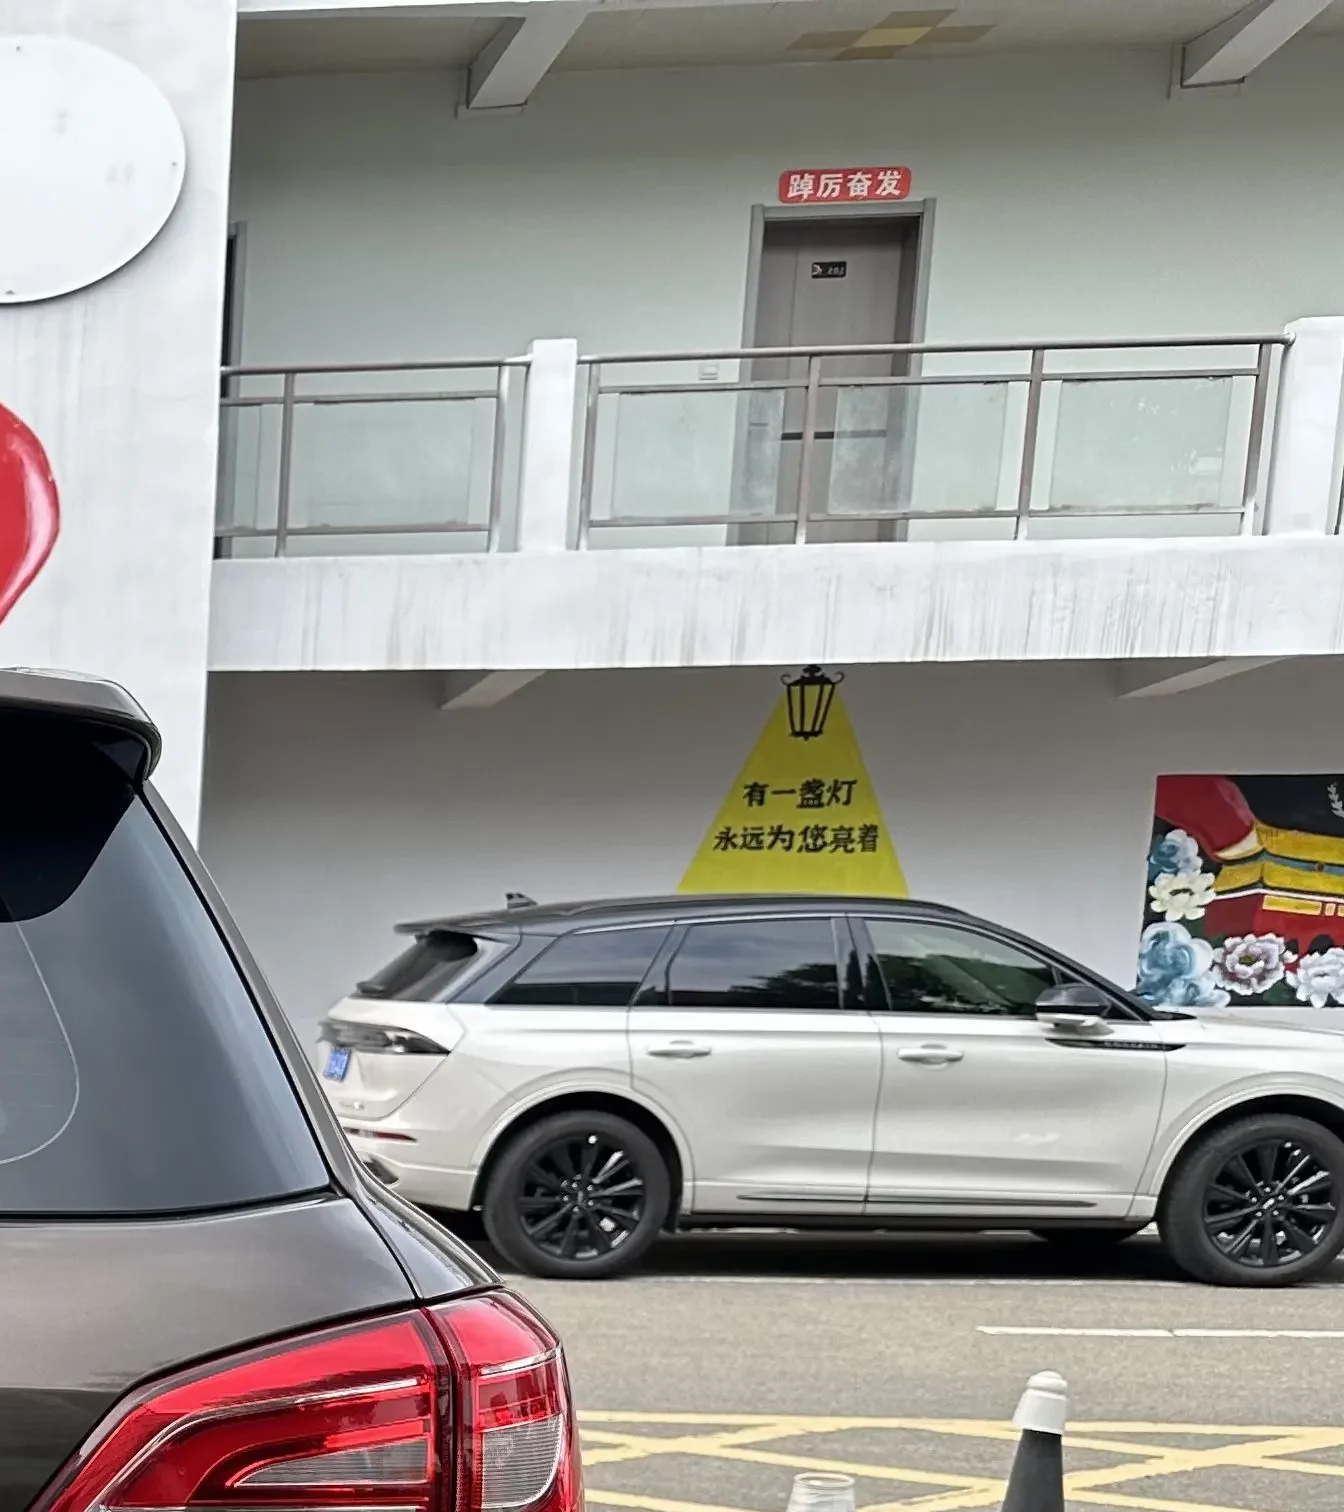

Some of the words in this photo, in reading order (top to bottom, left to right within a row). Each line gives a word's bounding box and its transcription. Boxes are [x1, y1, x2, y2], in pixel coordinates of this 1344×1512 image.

[787, 170, 902, 201] 踔厉奋发
[743, 778, 858, 809] 有一盏灯
[713, 824, 880, 853] 永远为您亮着
